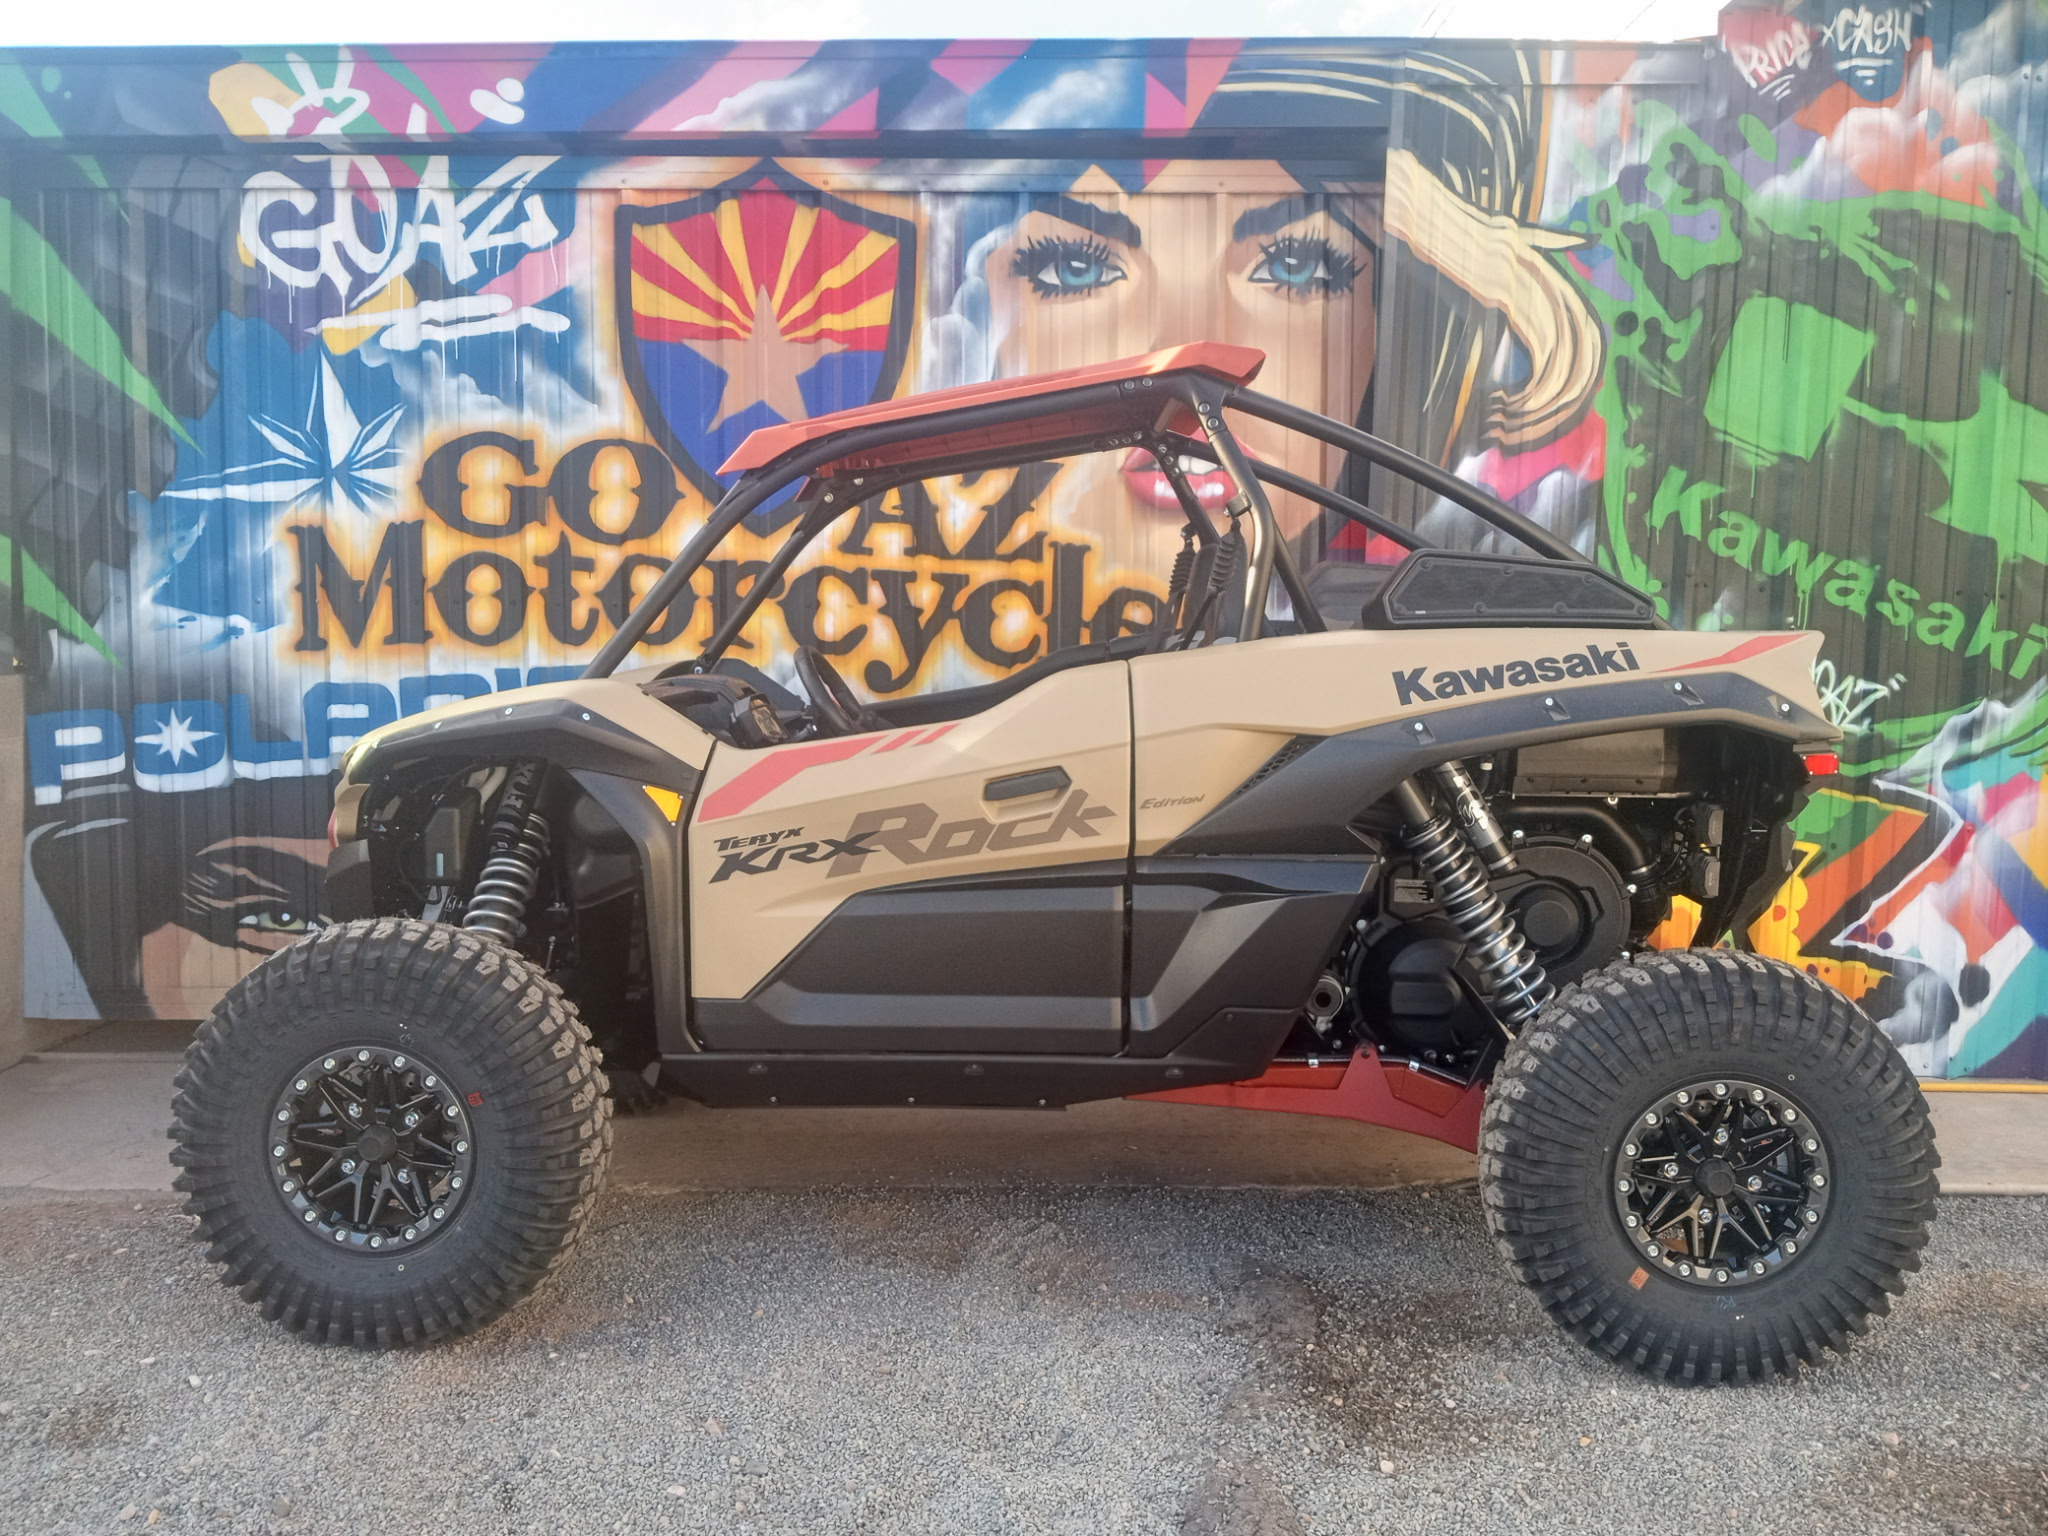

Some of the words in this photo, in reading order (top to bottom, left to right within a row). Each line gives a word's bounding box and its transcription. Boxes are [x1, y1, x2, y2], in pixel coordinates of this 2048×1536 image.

[418, 430, 686, 547] GO
[836, 462, 1064, 562] AZ
[1645, 464, 2048, 681] Kawasaki
[1391, 641, 1641, 706] Kawasaki
[708, 844, 882, 884] KRX
[825, 788, 1117, 879] Rock
[713, 826, 806, 852] TERYX
